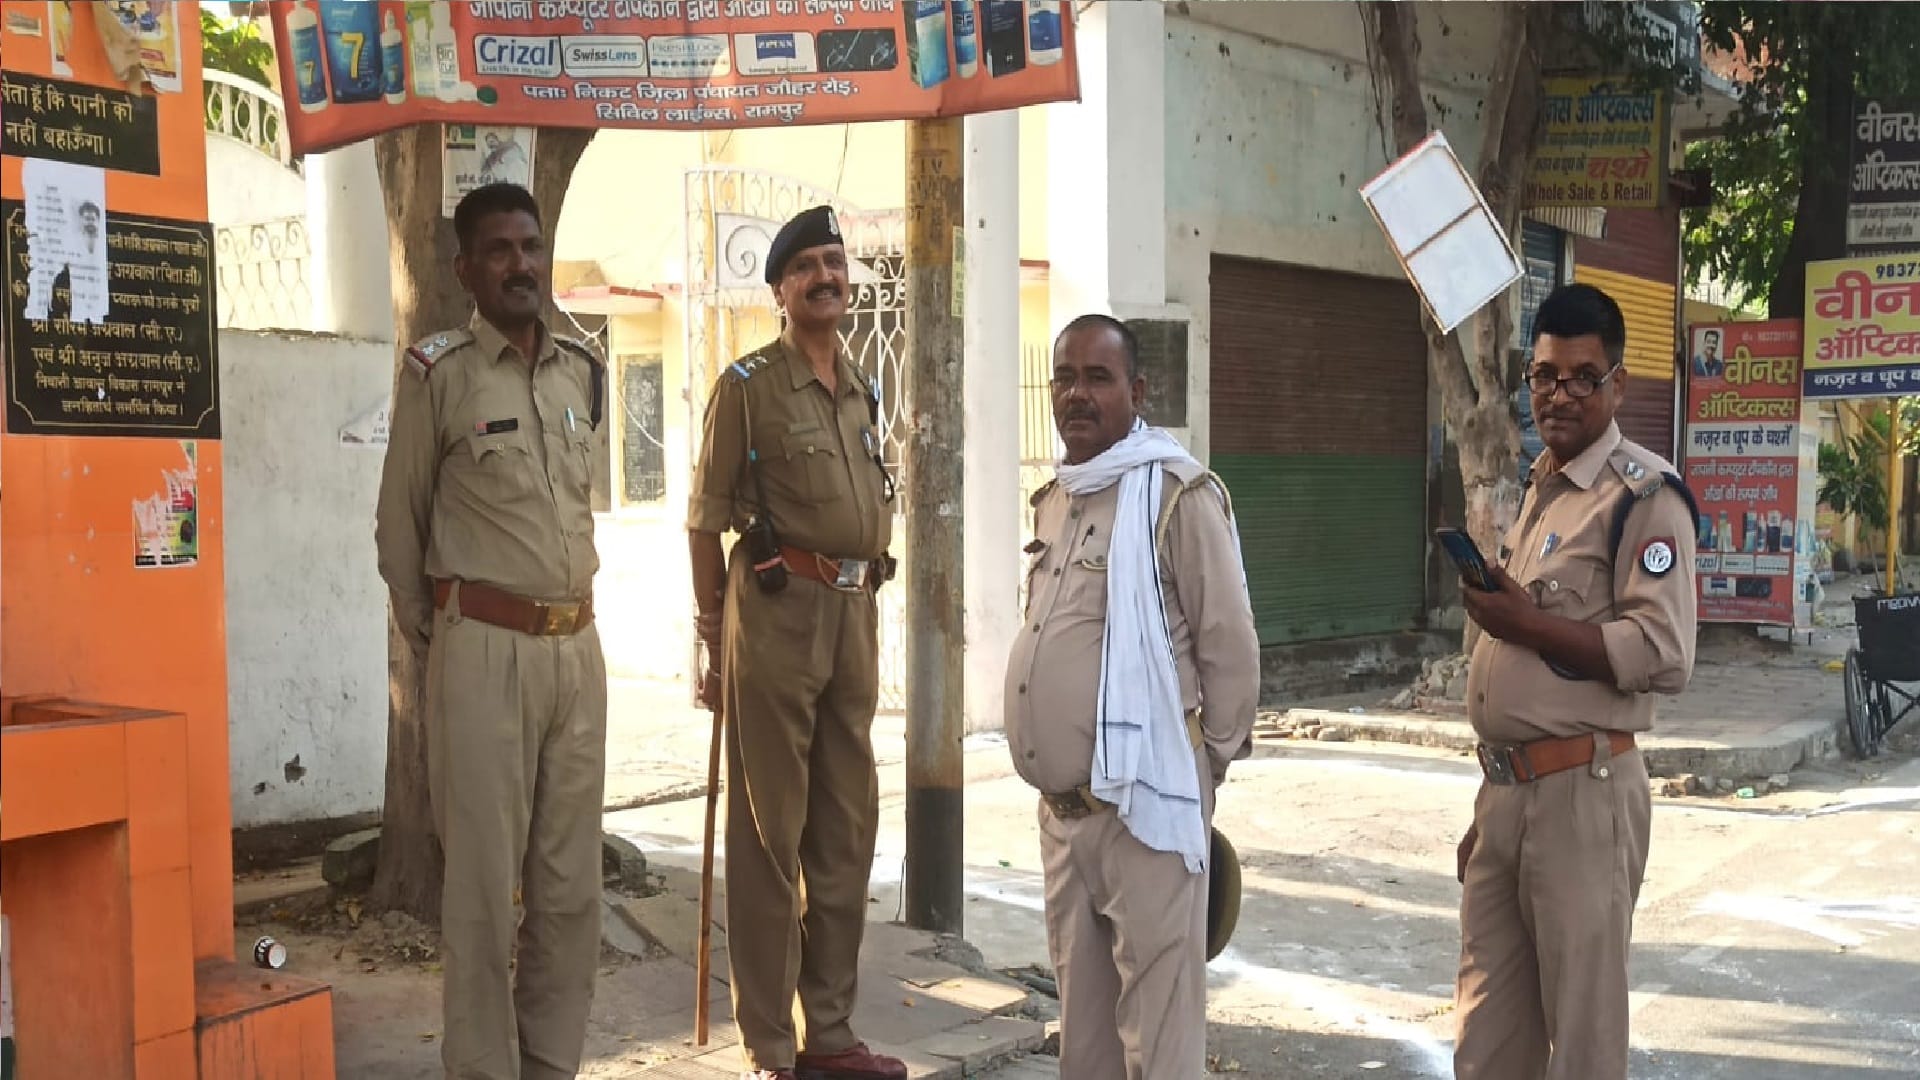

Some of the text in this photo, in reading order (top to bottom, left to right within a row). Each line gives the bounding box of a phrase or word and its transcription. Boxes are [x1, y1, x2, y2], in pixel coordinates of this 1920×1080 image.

[341, 32, 364, 79] 7
[479, 36, 554, 66] Crizal
[572, 47, 638, 63] SwissLens
[574, 82, 633, 100] निकट
[46, 83, 65, 111] कि
[69, 93, 107, 119] पानी
[110, 95, 133, 124] को
[596, 103, 659, 121] सिविल
[744, 103, 805, 123] रामपुर
[1526, 182, 1652, 201] Whole Sale & Retail
[114, 262, 155, 281] अग्रवाल
[1875, 262, 1920, 280] 9837
[1814, 269, 1920, 320] वीन
[1815, 324, 1920, 361] ऑप्टिक
[58, 344, 75, 366] श्री
[115, 351, 160, 371] अग्रवाल
[1724, 345, 1798, 384] वीनस
[143, 379, 173, 398] रामपुर
[1814, 372, 1857, 390] नज़र
[1860, 372, 1873, 384] व
[1879, 369, 1906, 390] धूप
[1698, 390, 1797, 418] ऑप्टिकल्स
[1694, 430, 1721, 452] नज़र
[1721, 430, 1731, 445] व
[1733, 430, 1750, 455] धूप
[1751, 424, 1764, 444] के
[1695, 555, 1718, 569] rizal
